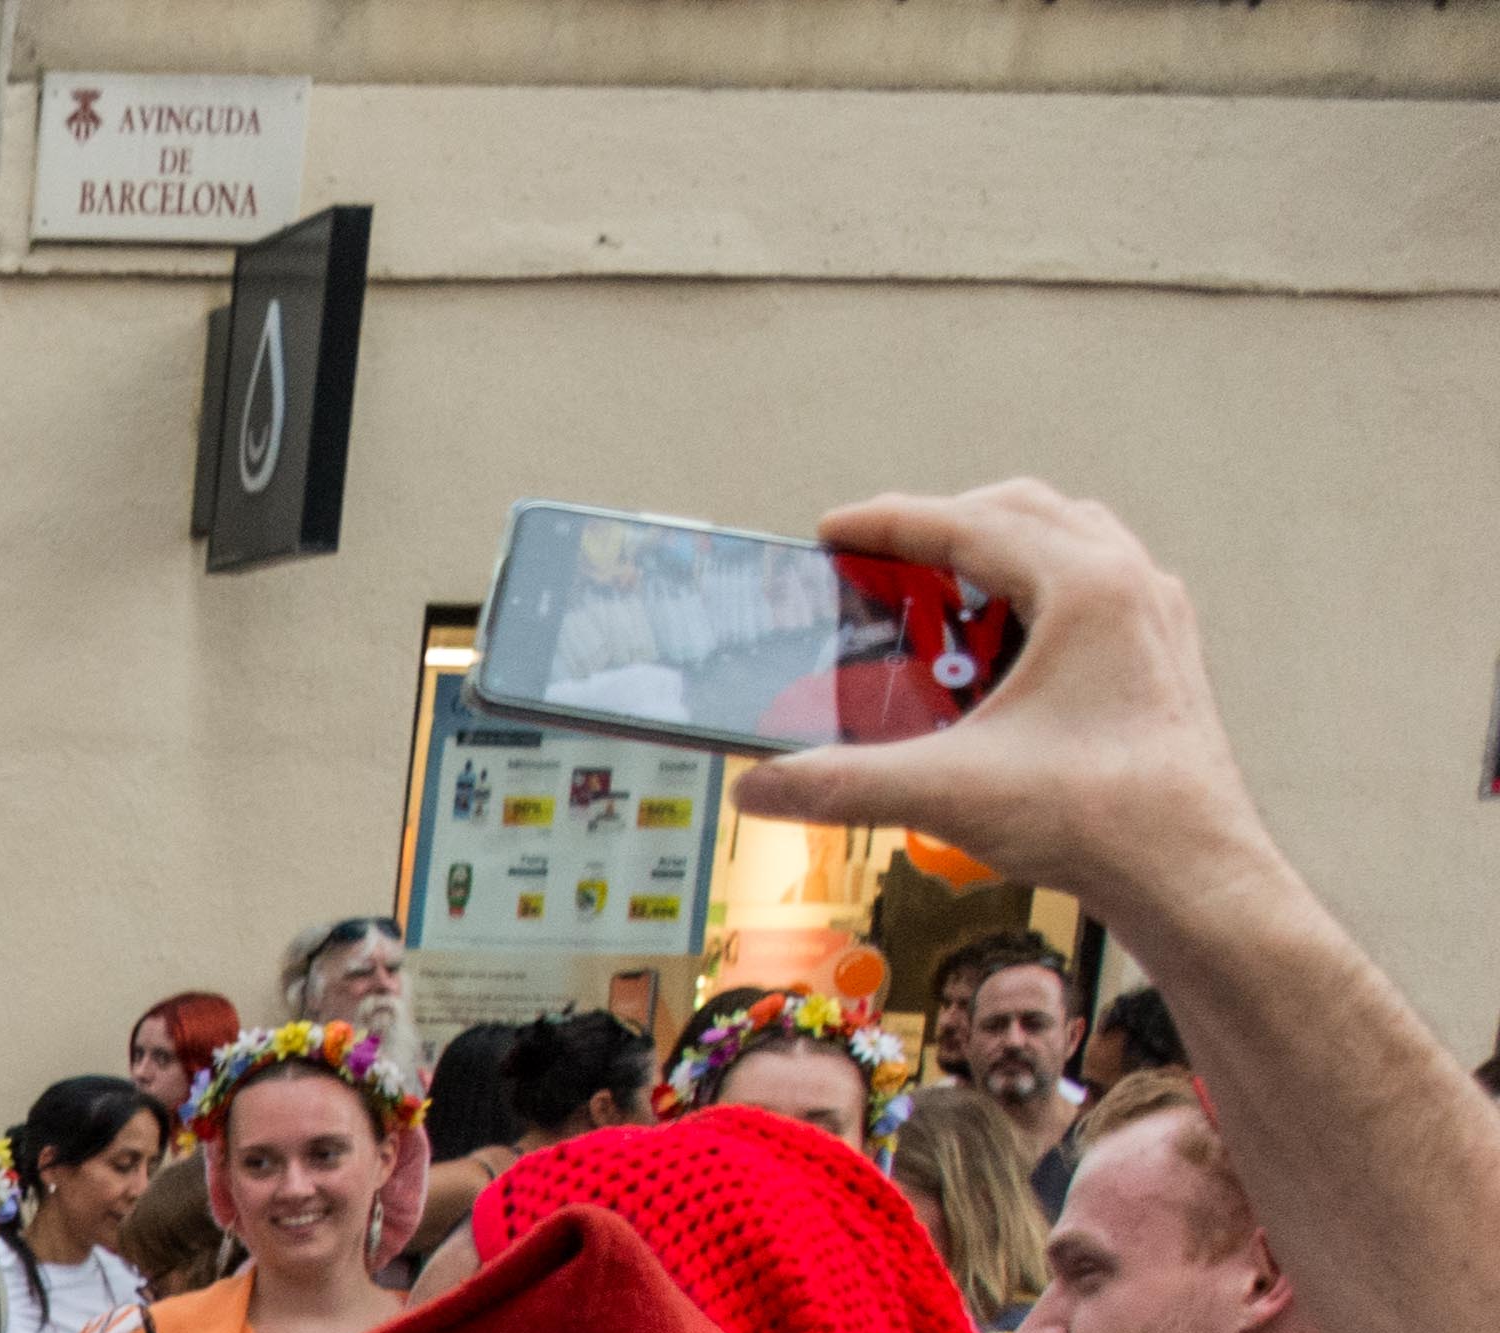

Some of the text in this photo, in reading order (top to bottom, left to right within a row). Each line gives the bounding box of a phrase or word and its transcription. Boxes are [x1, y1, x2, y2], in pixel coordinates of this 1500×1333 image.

[120, 106, 261, 135] AVINGUDA
[159, 147, 192, 174] DE
[80, 181, 258, 217] BARCELONA
